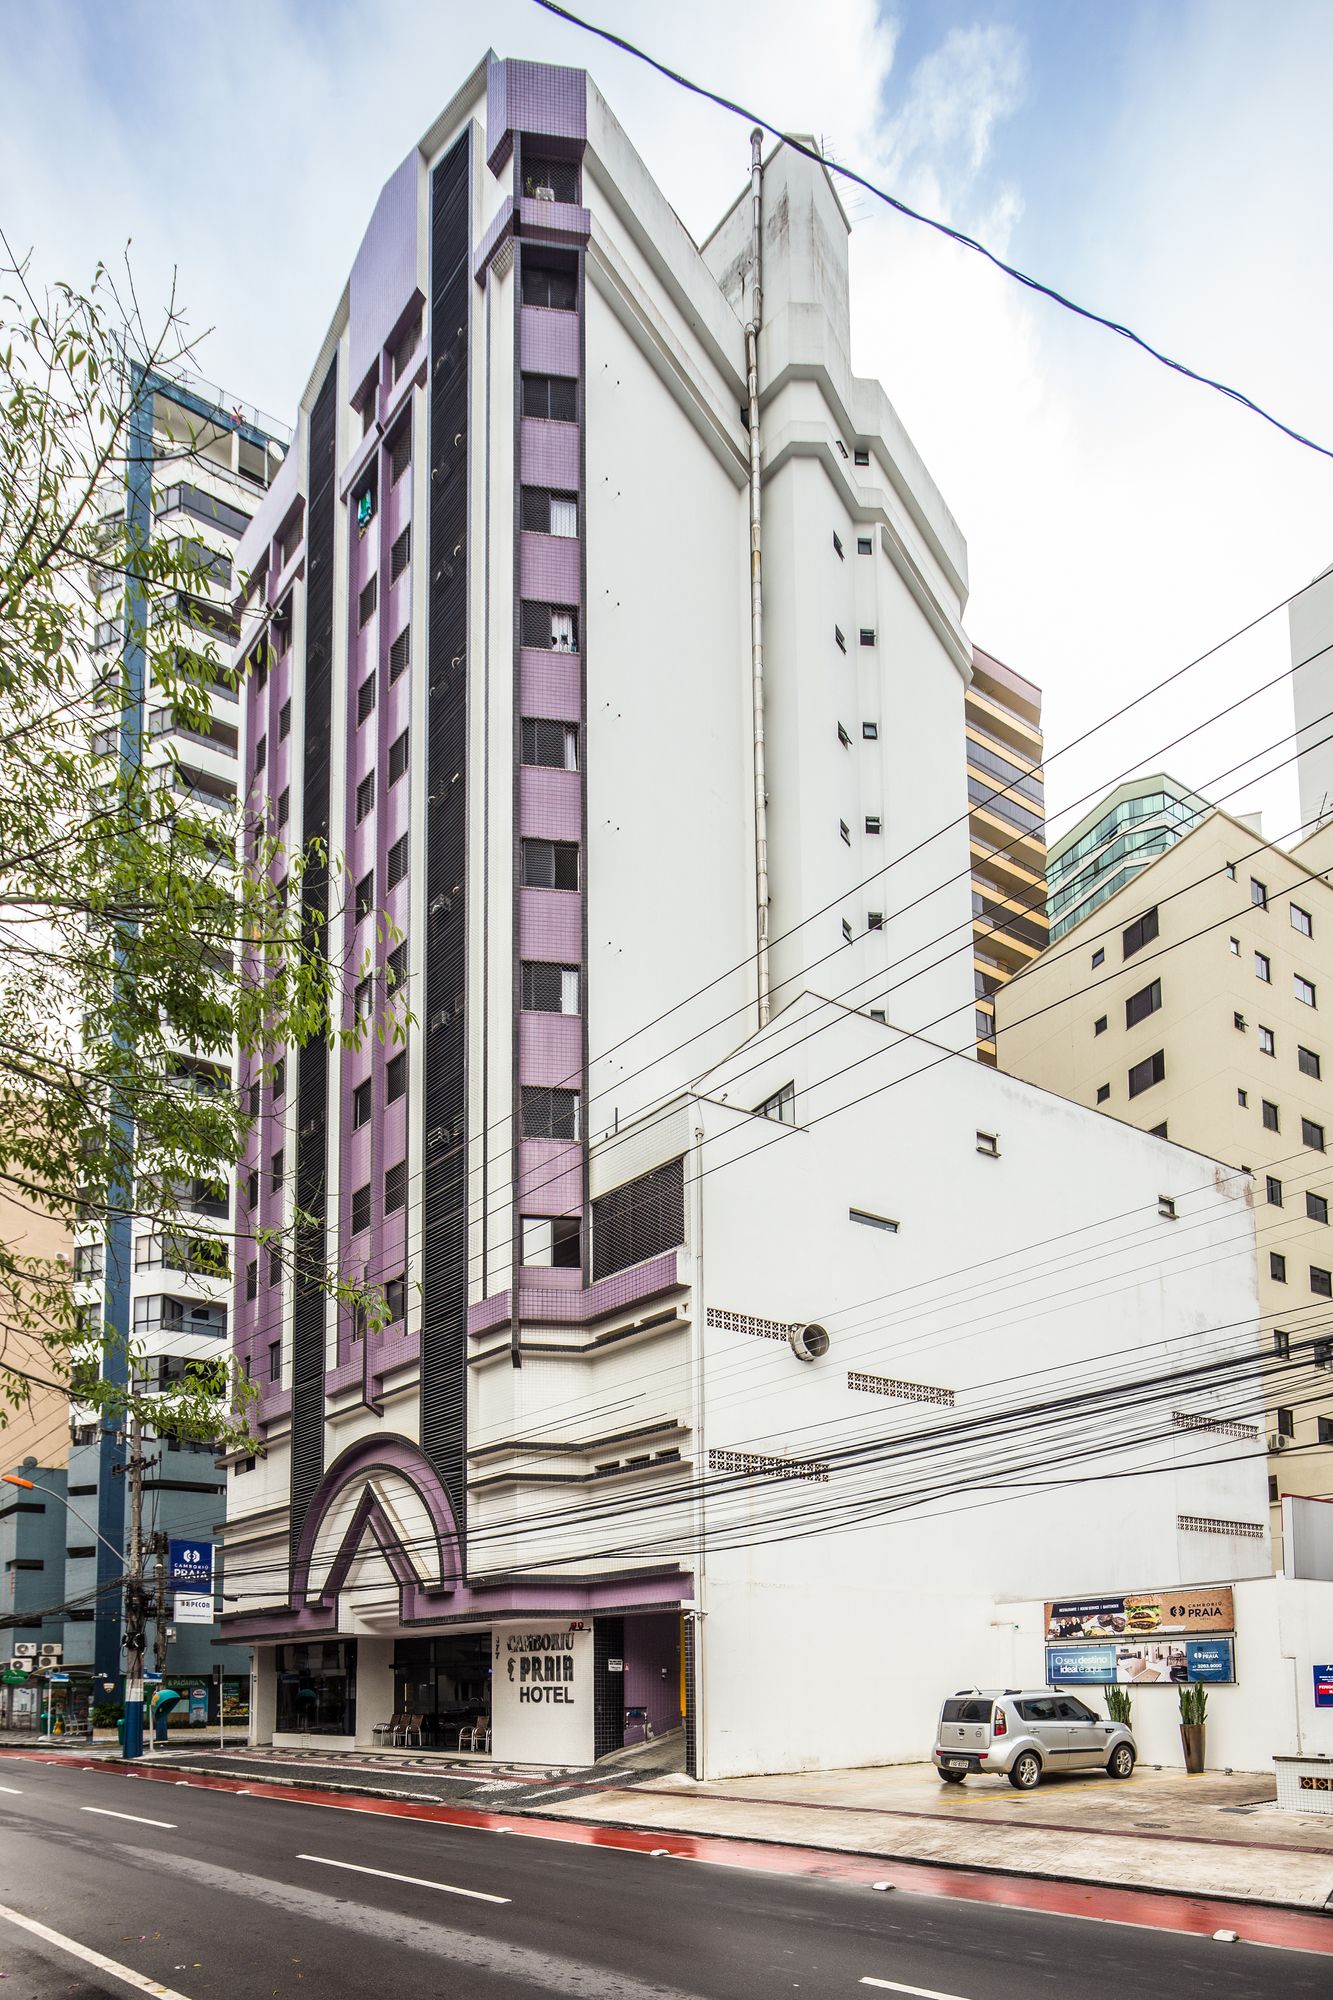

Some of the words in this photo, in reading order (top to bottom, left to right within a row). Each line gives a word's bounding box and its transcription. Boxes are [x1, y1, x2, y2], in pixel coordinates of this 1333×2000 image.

[1188, 1607, 1222, 1617] PRAIA
[1055, 1656, 1063, 1665] O
[1078, 1656, 1108, 1664] destino
[519, 1655, 574, 1682] PRAIA
[1060, 1665, 1078, 1673] ideal
[520, 1686, 574, 1703] HOTEL
